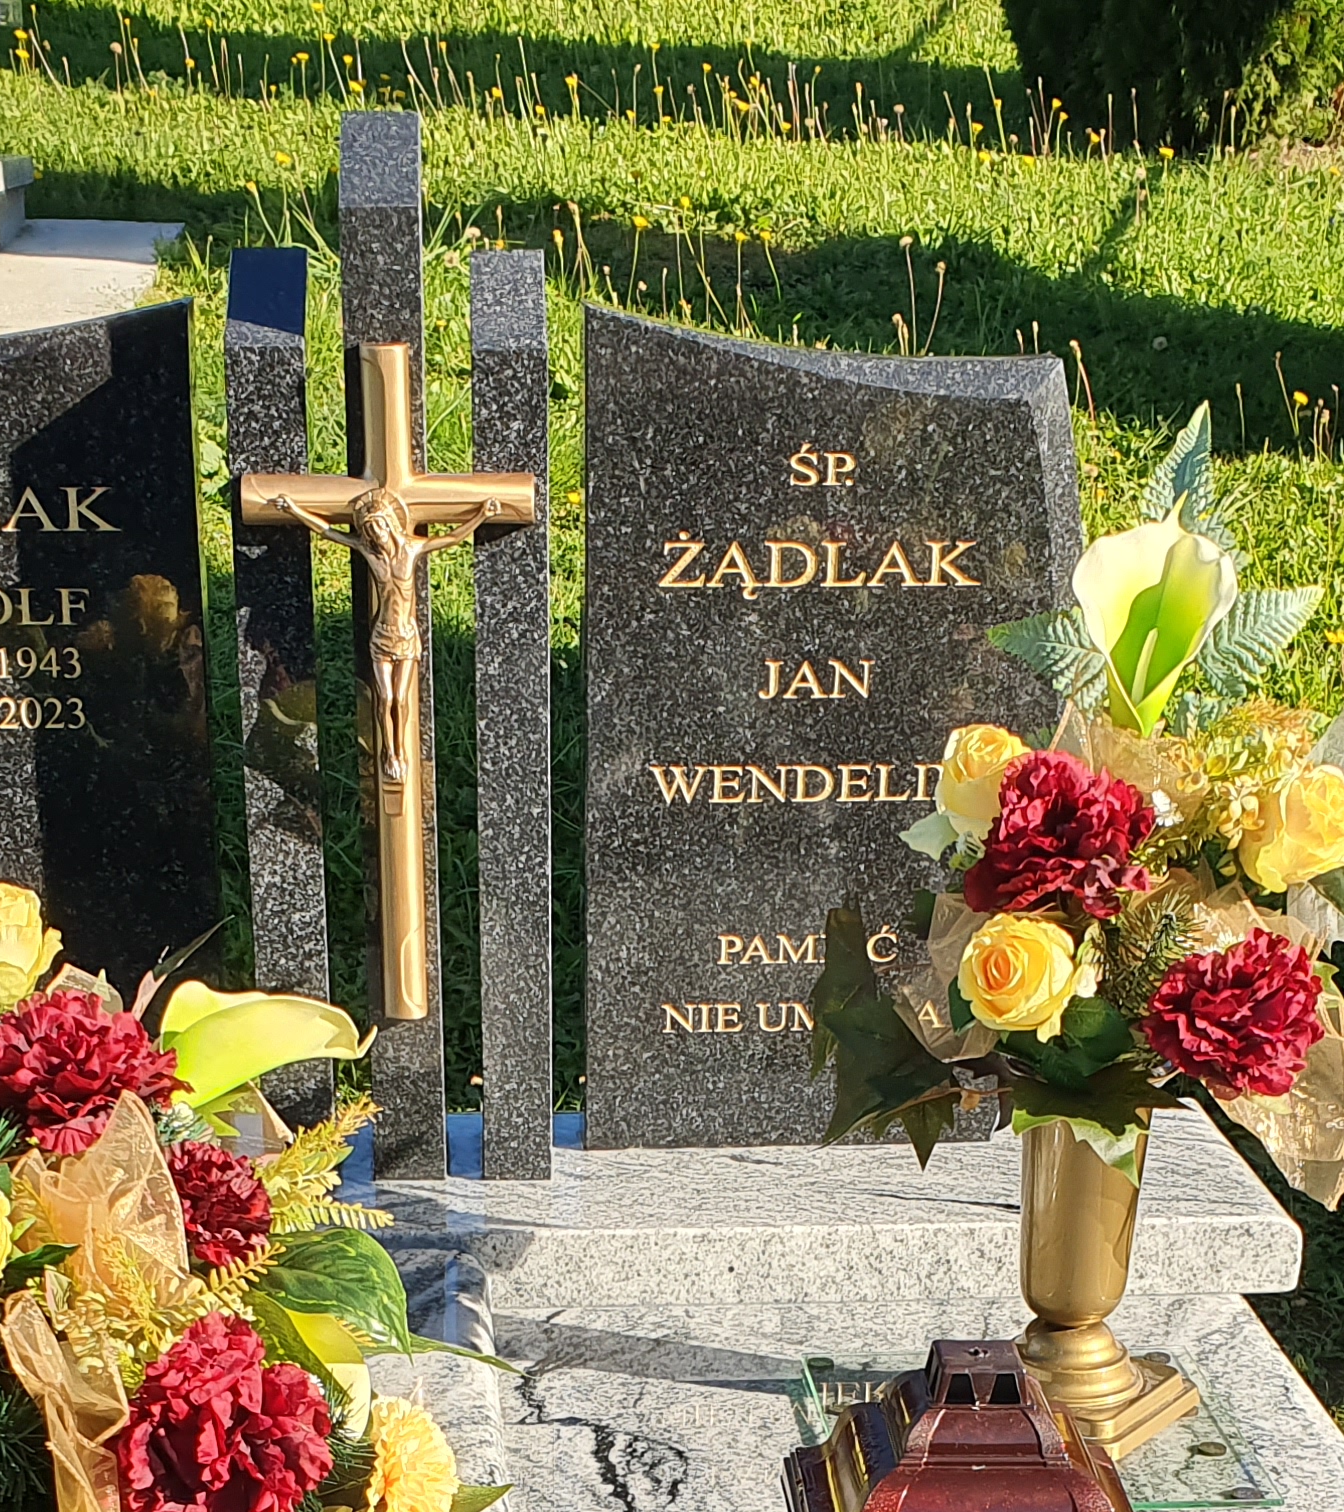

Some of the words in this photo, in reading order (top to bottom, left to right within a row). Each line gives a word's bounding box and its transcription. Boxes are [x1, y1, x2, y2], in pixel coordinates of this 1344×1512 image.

[658, 530, 982, 600] ŻĄDLAK
[758, 658, 876, 700] JAN
[649, 763, 945, 805] WENDELI
[716, 925, 899, 966] PAMĆ
[660, 1001, 745, 1034] NIE
